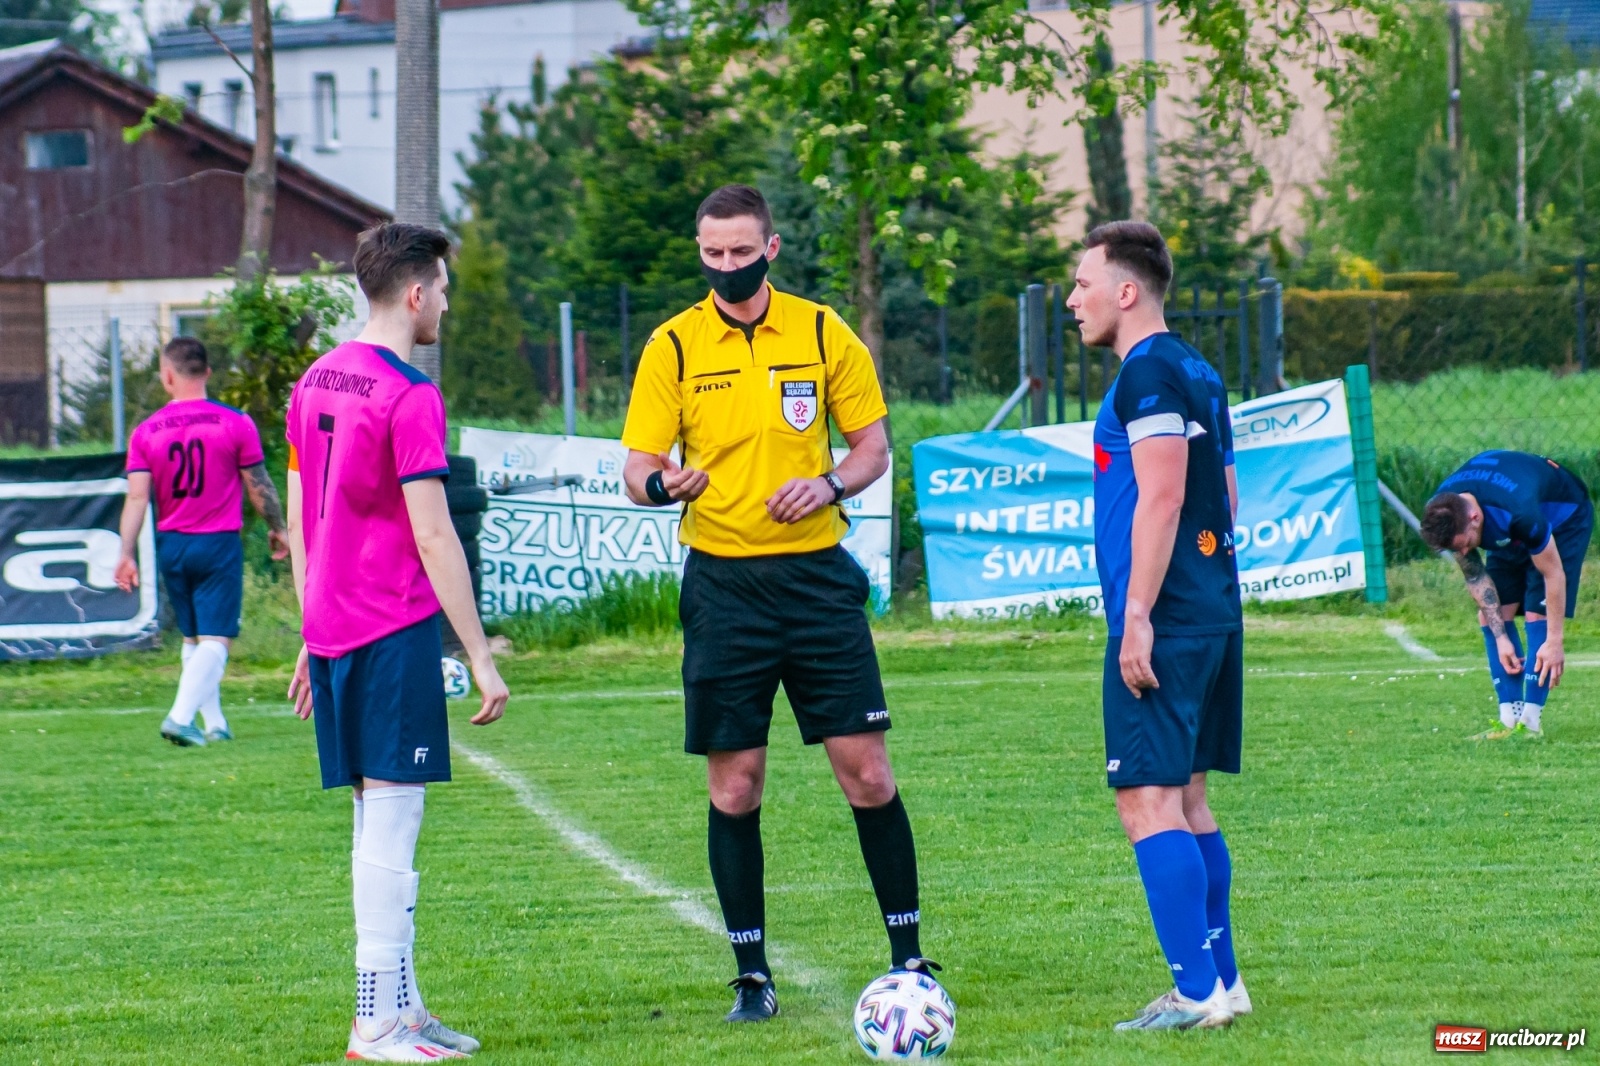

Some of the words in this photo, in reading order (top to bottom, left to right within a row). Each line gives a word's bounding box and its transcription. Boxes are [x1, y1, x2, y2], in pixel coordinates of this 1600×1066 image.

[168, 438, 205, 499] 20
[318, 412, 336, 519] 7
[928, 461, 1048, 496] SZYBKI
